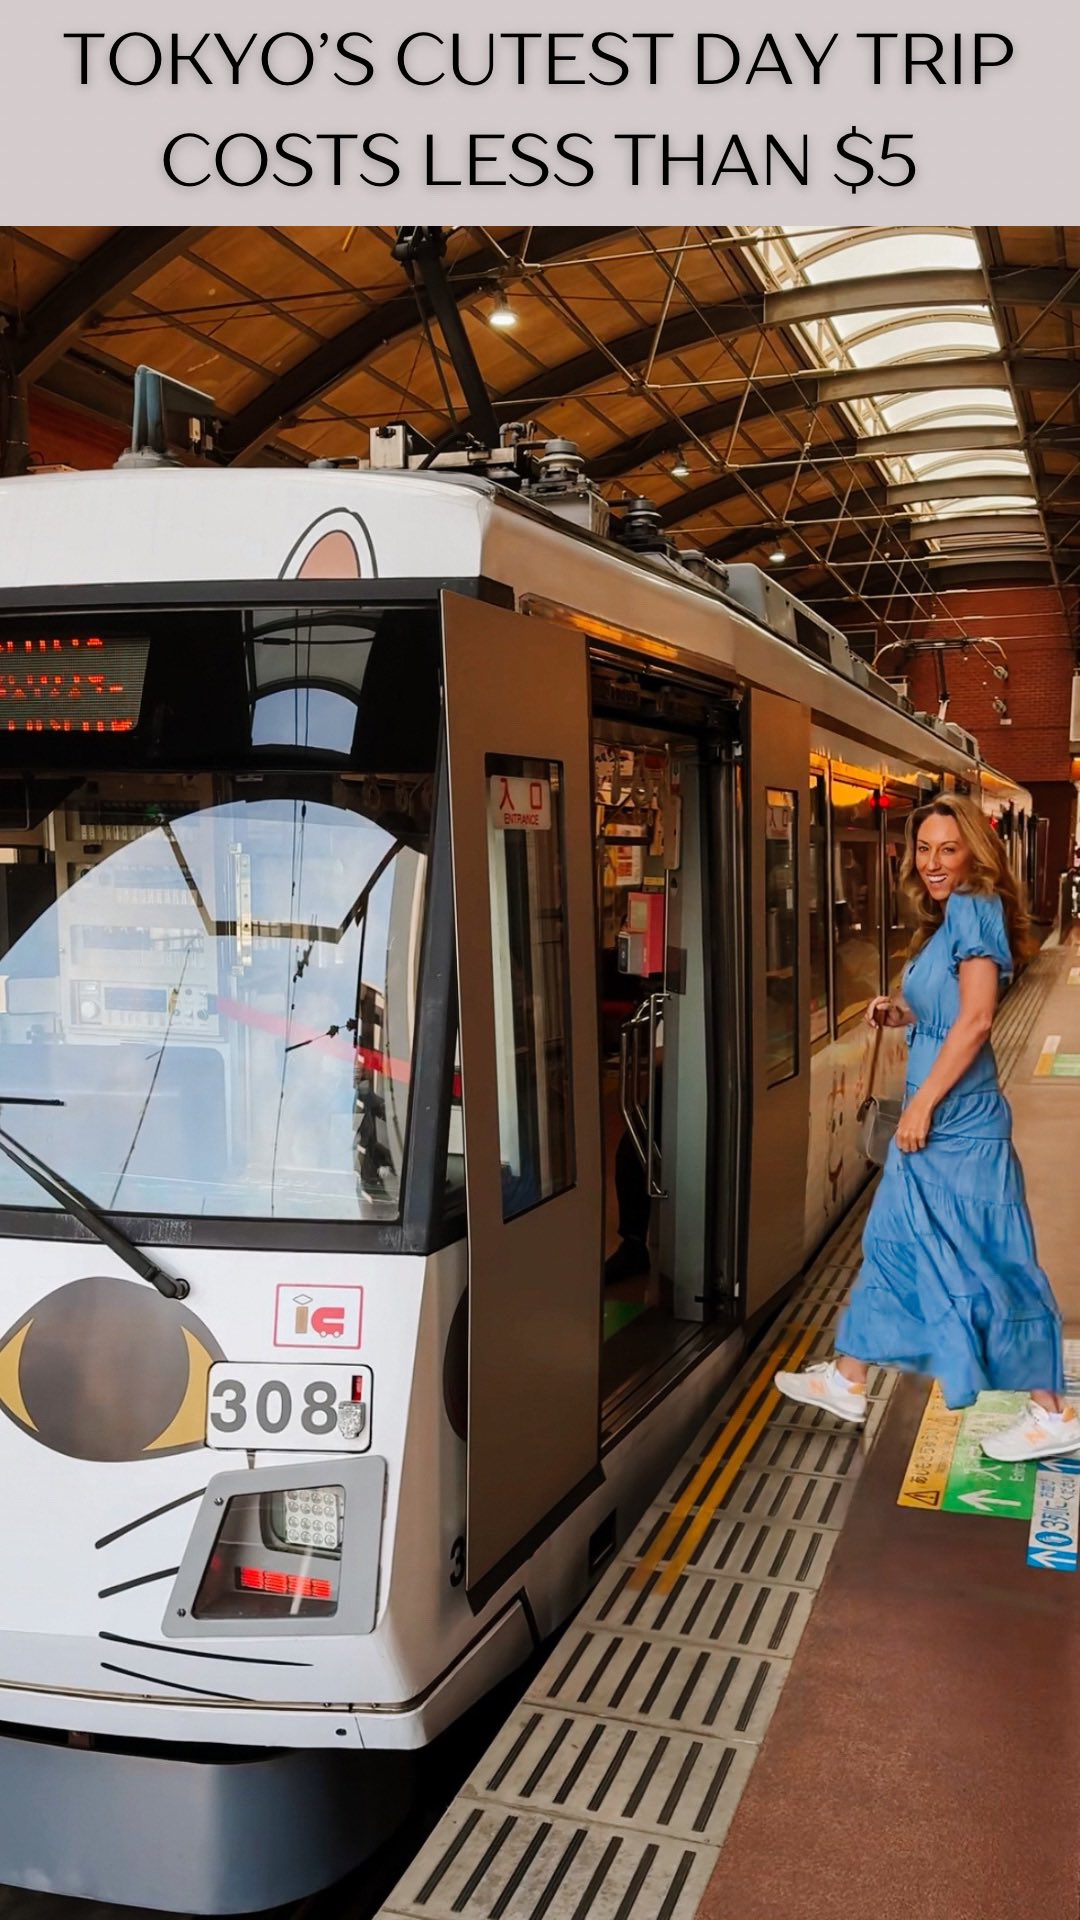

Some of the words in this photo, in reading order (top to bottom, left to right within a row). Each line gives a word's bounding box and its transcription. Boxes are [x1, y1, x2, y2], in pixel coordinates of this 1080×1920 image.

[499, 777, 543, 810] 入口
[503, 812, 539, 826] ENTRANCE
[209, 1379, 338, 1435] 308
